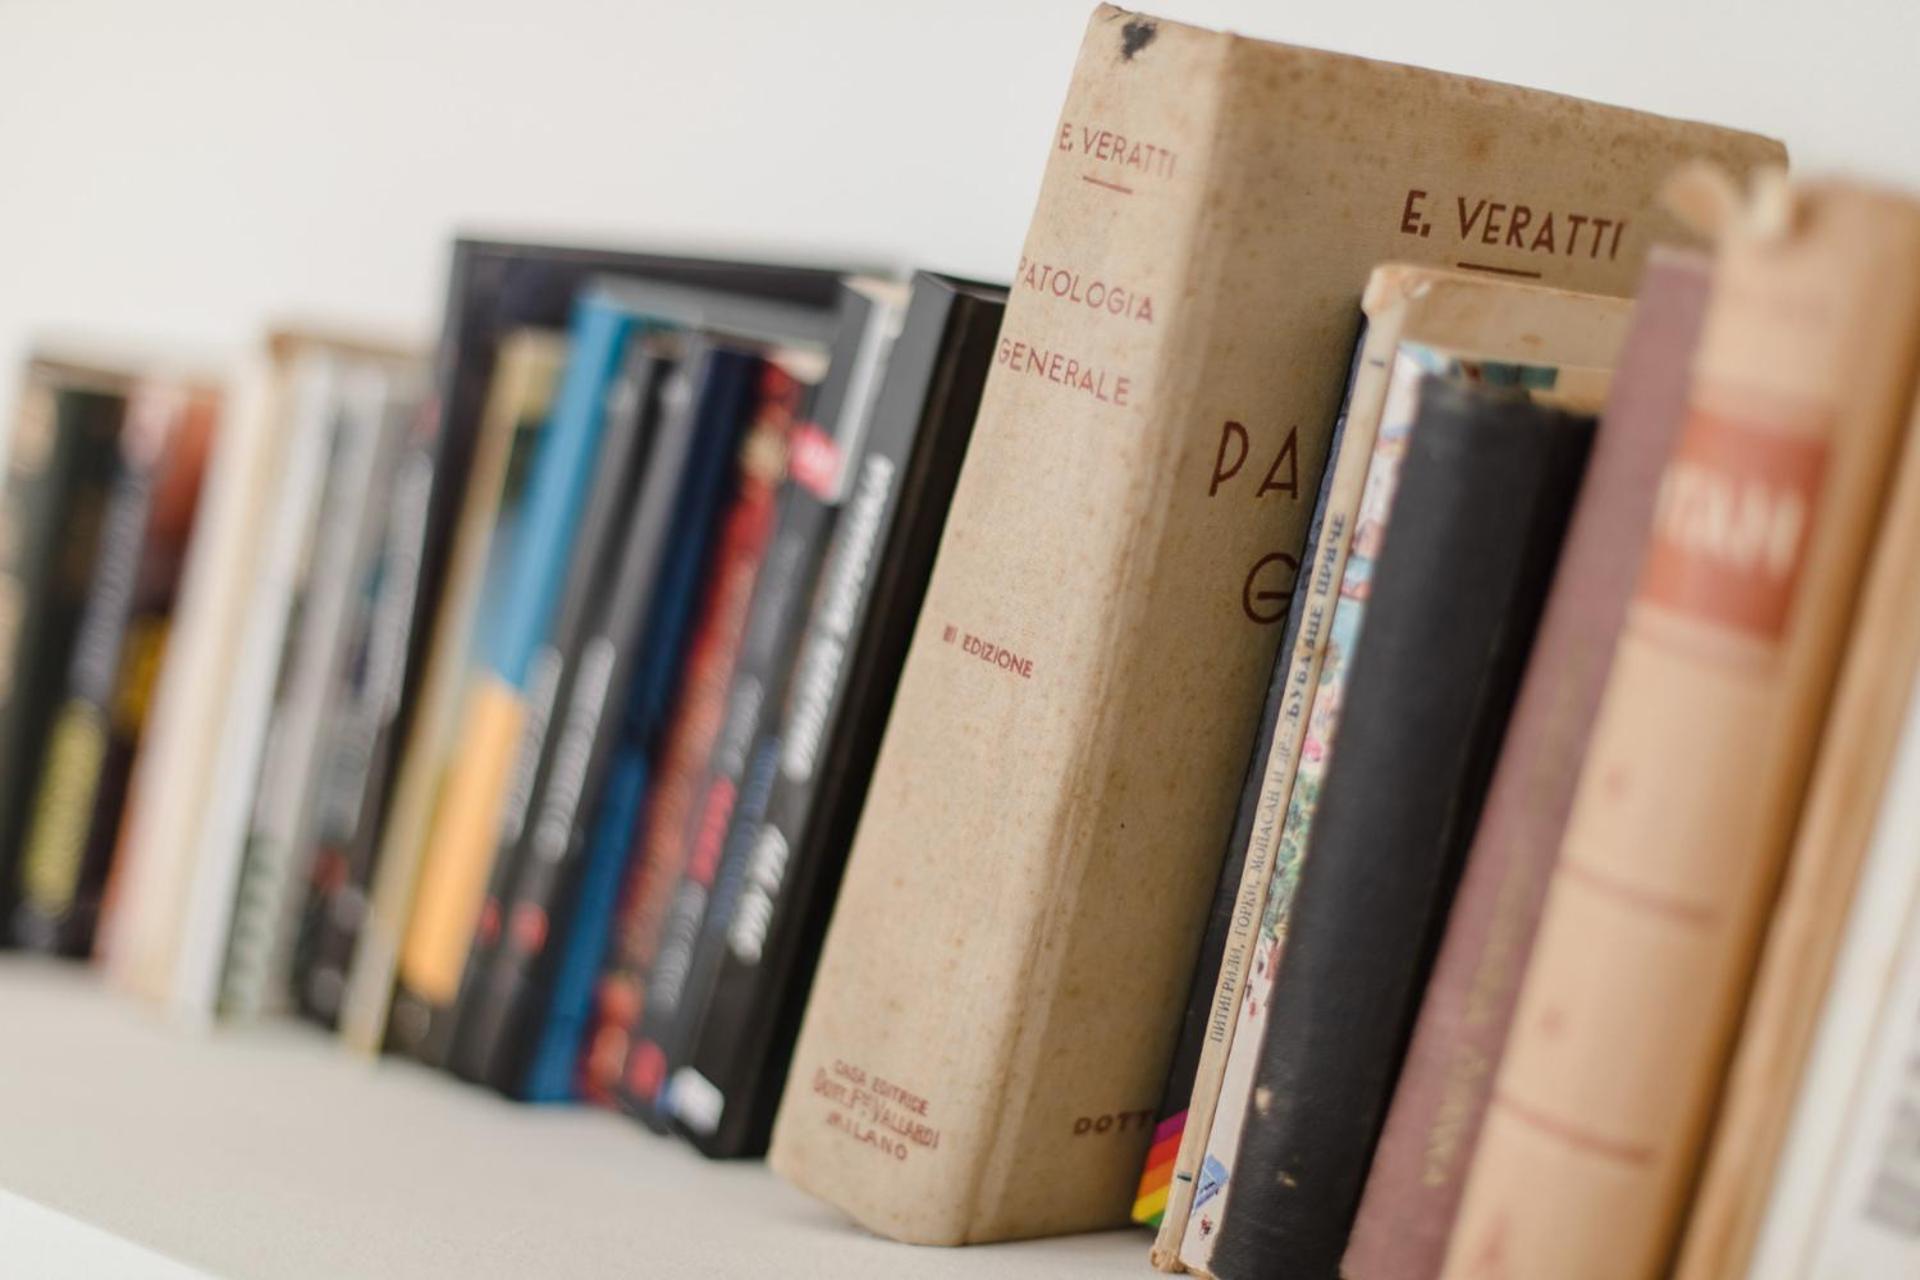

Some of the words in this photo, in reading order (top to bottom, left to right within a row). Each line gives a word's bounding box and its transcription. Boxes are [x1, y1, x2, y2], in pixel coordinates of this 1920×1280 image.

[1083, 126, 1178, 179] VERATTI
[1401, 190, 1431, 237] E.
[1457, 197, 1625, 261] VERATTI
[998, 338, 1132, 407] GENERALE
[962, 634, 1033, 679] EDIZIONE
[1250, 790, 1280, 873] МОПАСАН
[1315, 514, 1345, 596] ПРИЧЕ
[834, 1059, 867, 1085] CASA
[872, 1077, 929, 1117] EDITRICE
